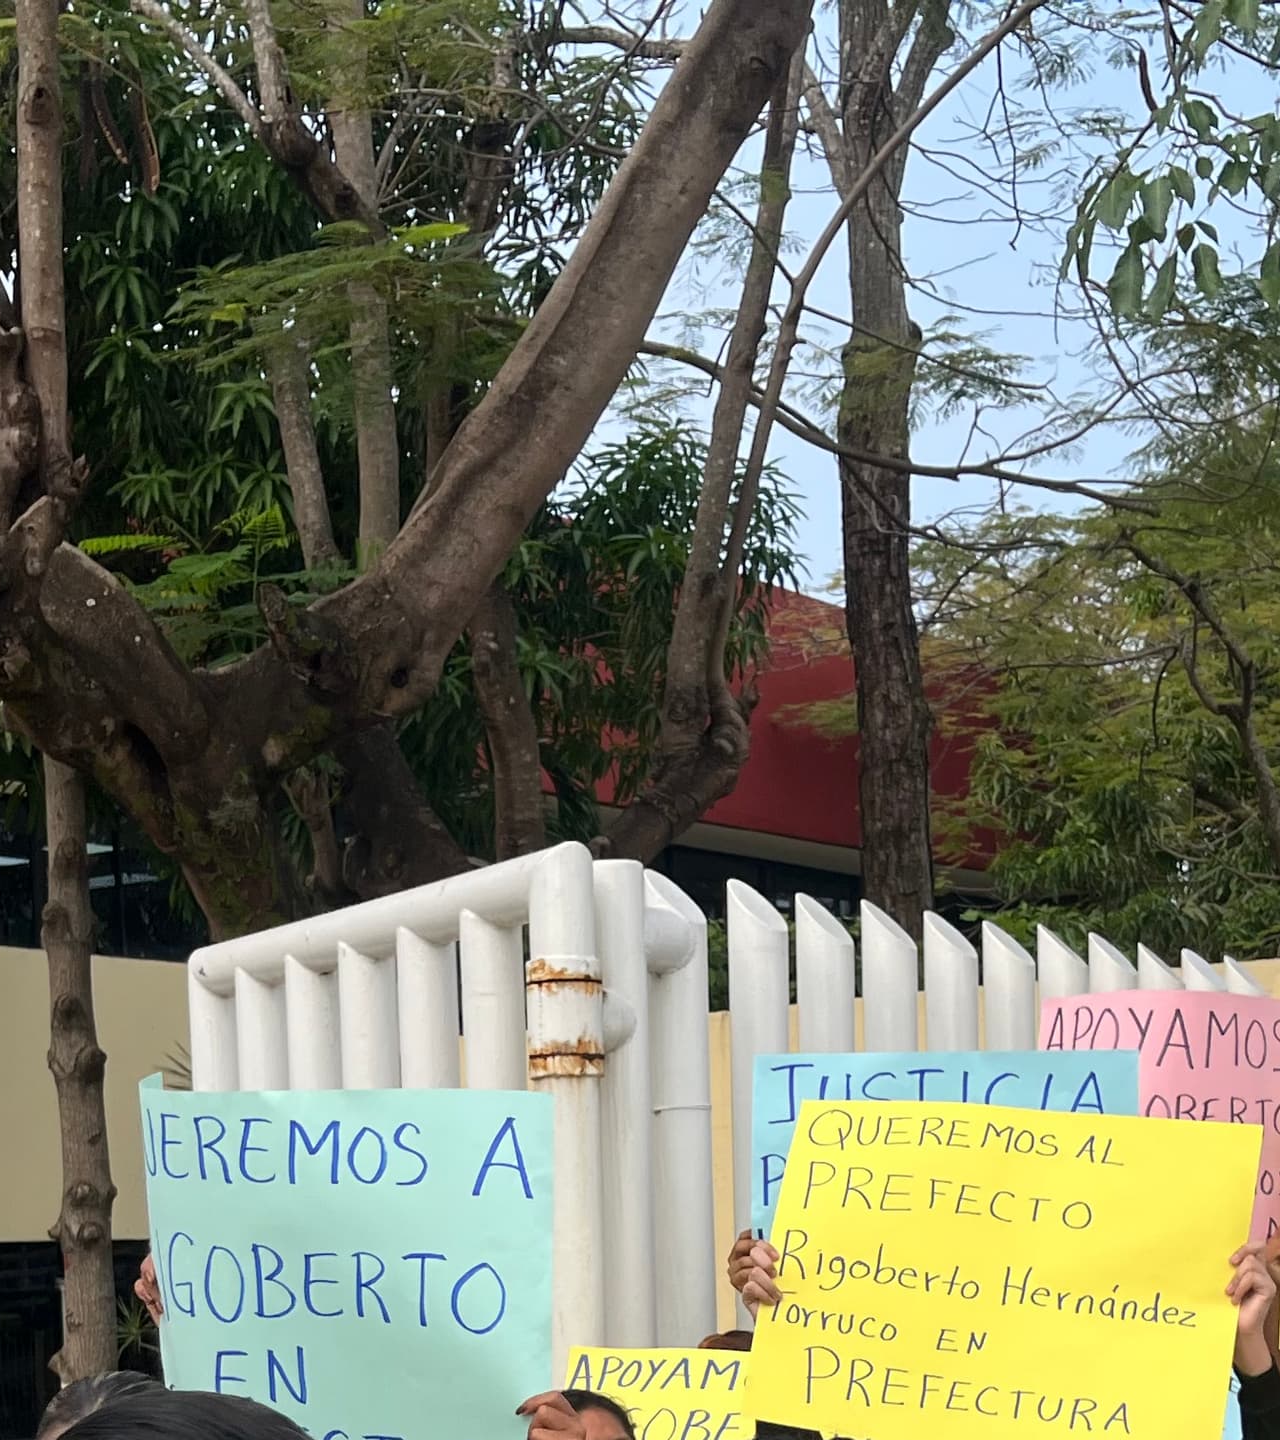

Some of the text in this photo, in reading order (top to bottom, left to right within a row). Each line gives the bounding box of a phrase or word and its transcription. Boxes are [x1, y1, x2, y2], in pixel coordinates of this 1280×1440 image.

[472, 1116, 534, 1200] A
[808, 1109, 1124, 1167] QUEREMOS AL
[803, 1161, 1093, 1229] PREFECTO
[778, 1229, 1197, 1328] Rigoberto Hernández
[568, 1353, 751, 1392] APOYAM
[936, 1328, 988, 1354] EN
[215, 1345, 308, 1405] EN
[804, 1345, 1131, 1434] PREFECTURA
